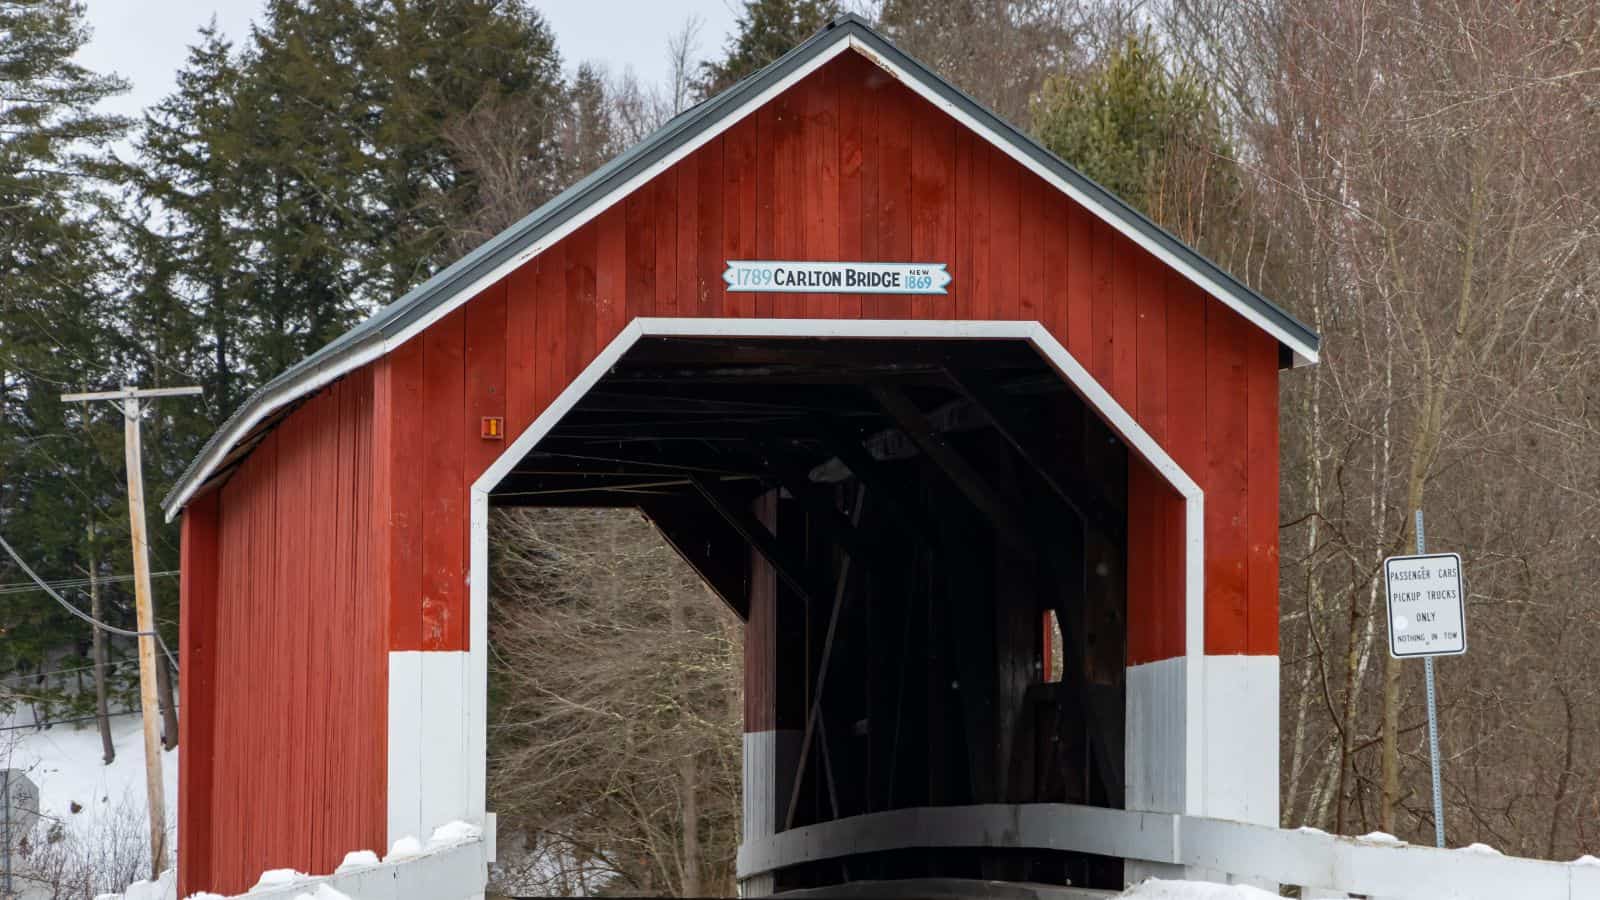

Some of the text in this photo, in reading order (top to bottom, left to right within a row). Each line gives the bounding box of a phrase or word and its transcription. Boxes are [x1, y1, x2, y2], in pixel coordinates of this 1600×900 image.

[737, 268, 900, 287] 1789 CARLTON BRIDGE
[905, 276, 932, 289] 1869
[1391, 568, 1457, 581] PASSENGER CARS
[1393, 590, 1456, 602] PICKUP TRUCKS
[1416, 612, 1436, 622] ONLY
[1397, 634, 1425, 643] NOTHING
[1444, 632, 1457, 640] TOW
